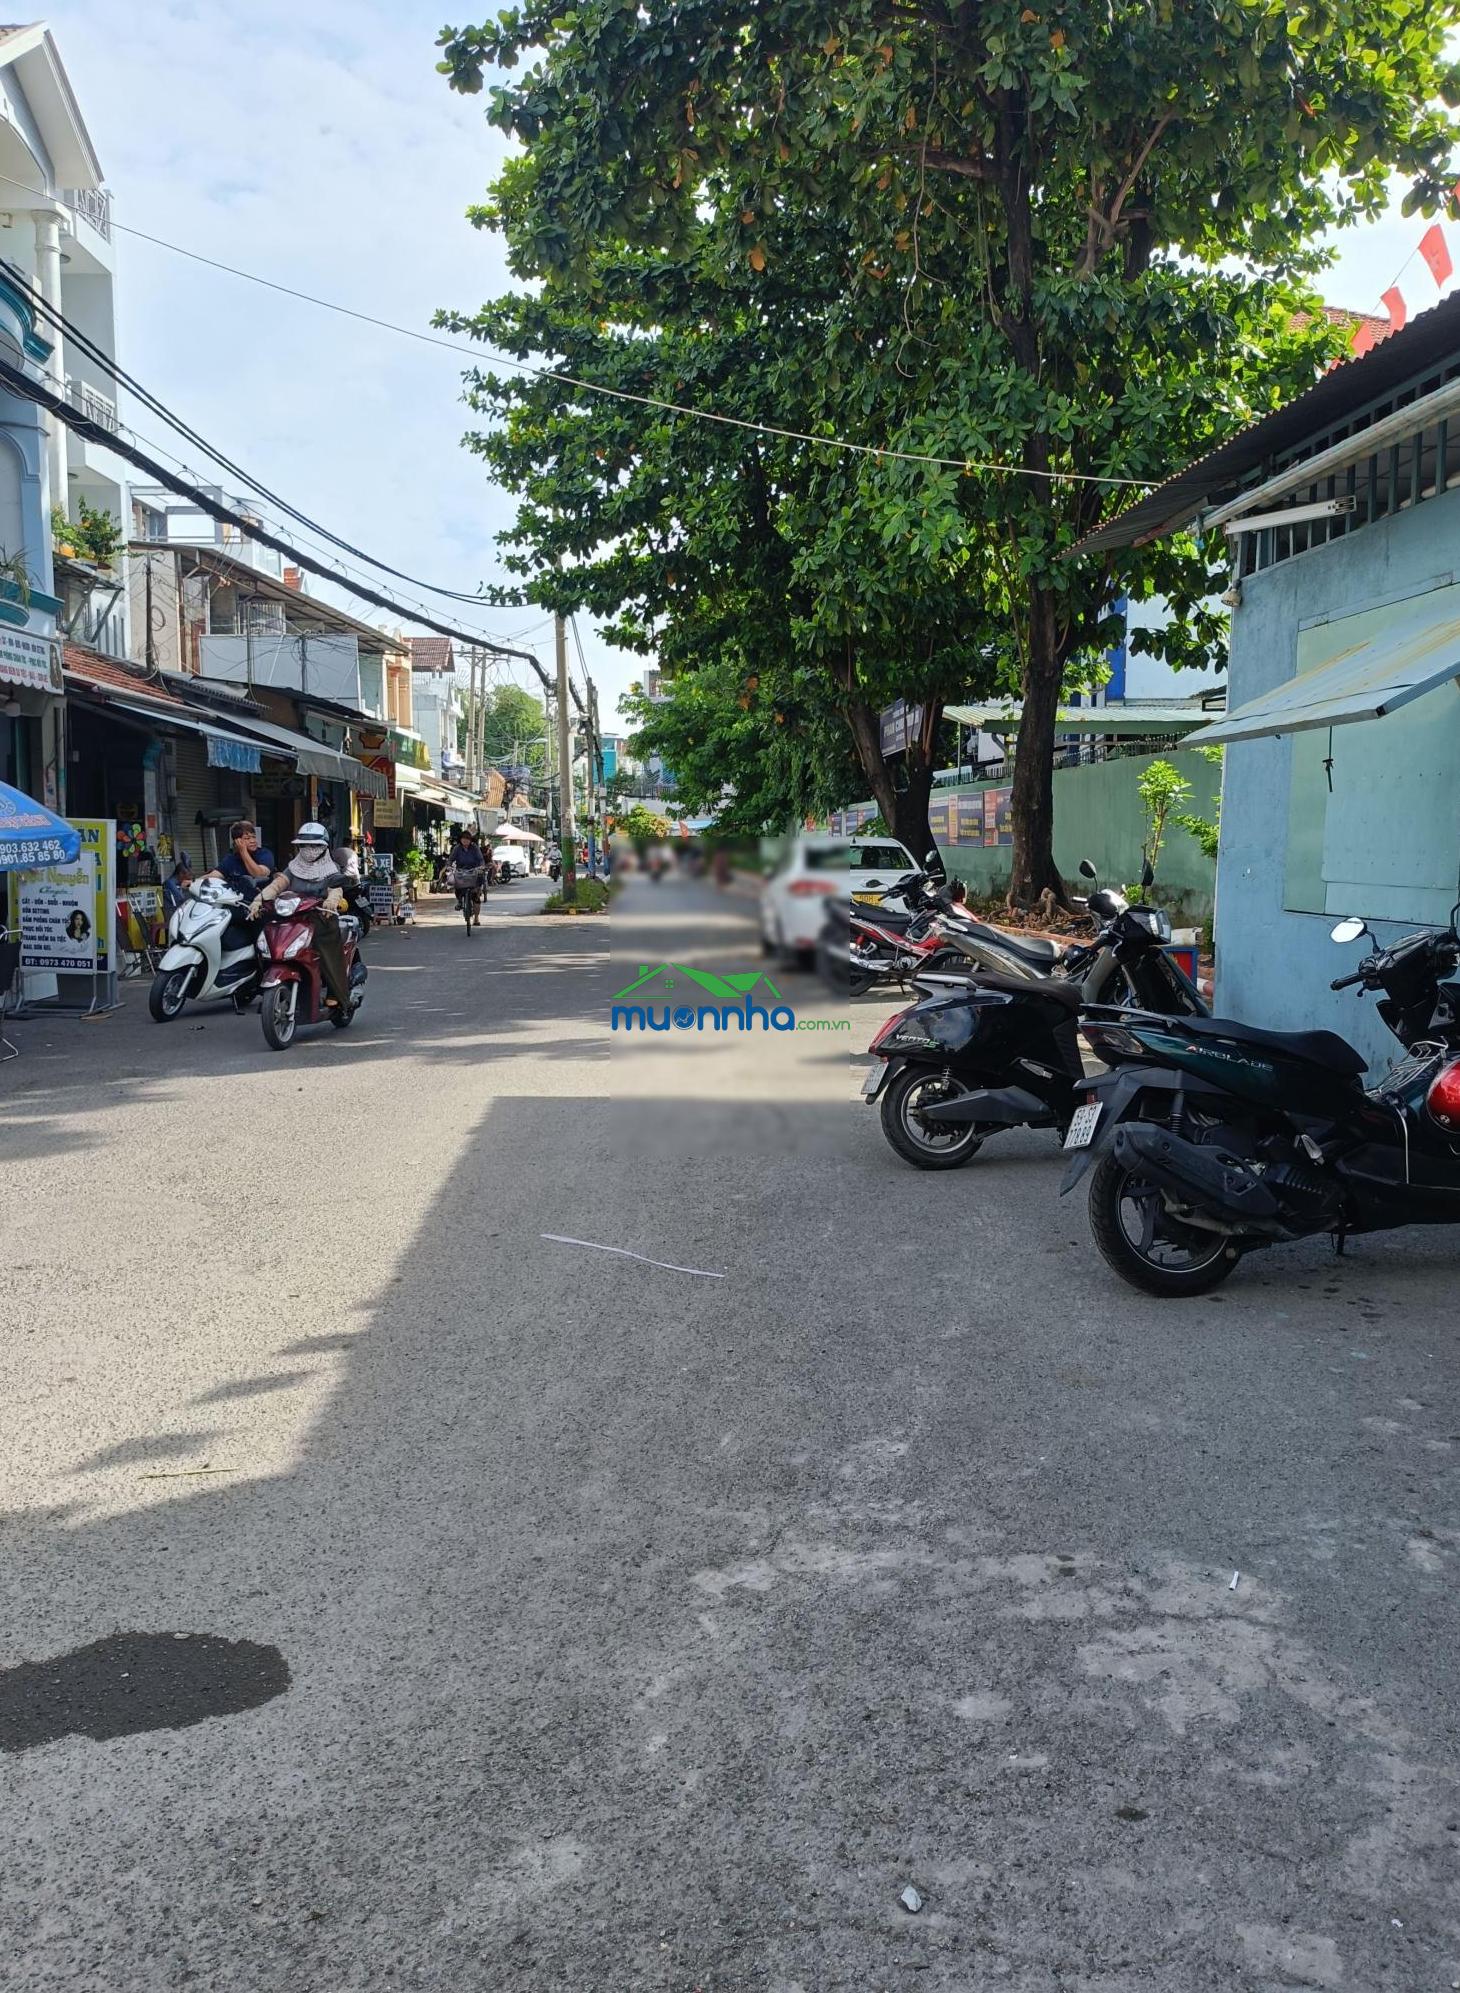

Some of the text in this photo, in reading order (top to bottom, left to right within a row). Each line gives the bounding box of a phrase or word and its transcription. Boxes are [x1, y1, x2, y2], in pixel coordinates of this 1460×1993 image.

[42, 840, 60, 851] 462
[37, 851, 51, 861] 85
[53, 849, 66, 860] 80
[40, 958, 59, 966] 0973
[60, 959, 75, 967] 470
[77, 960, 91, 968] 051
[896, 1034, 931, 1044] VENTO
